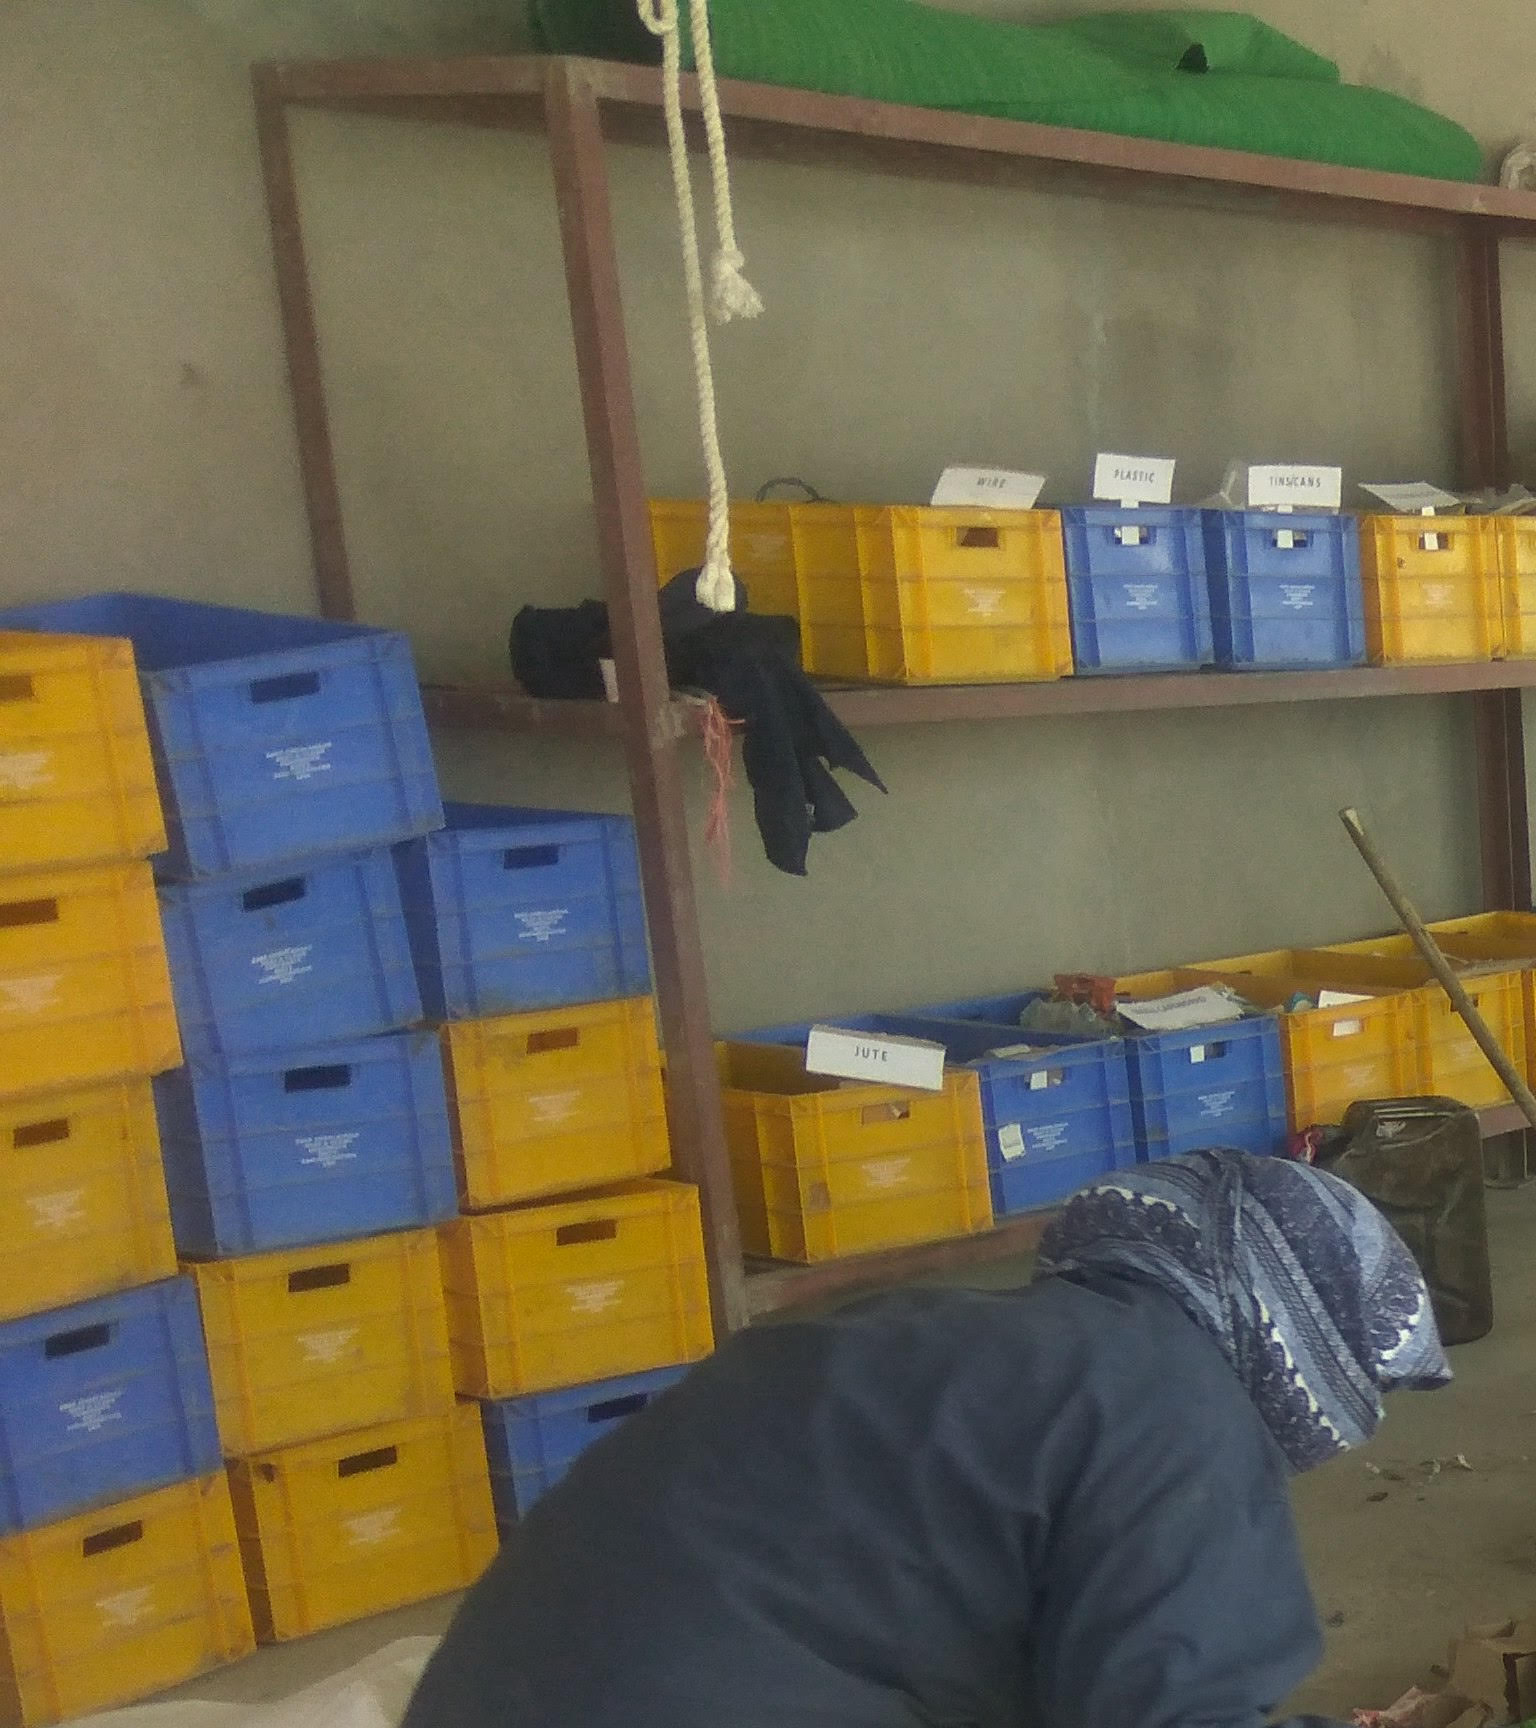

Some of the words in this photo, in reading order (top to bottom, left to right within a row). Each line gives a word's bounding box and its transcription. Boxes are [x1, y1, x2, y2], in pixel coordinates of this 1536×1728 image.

[977, 476, 1008, 490] WIRE
[1113, 468, 1156, 485] PLASTIC
[1270, 476, 1321, 489] TINS/CANS
[854, 1046, 888, 1062] JUTE
